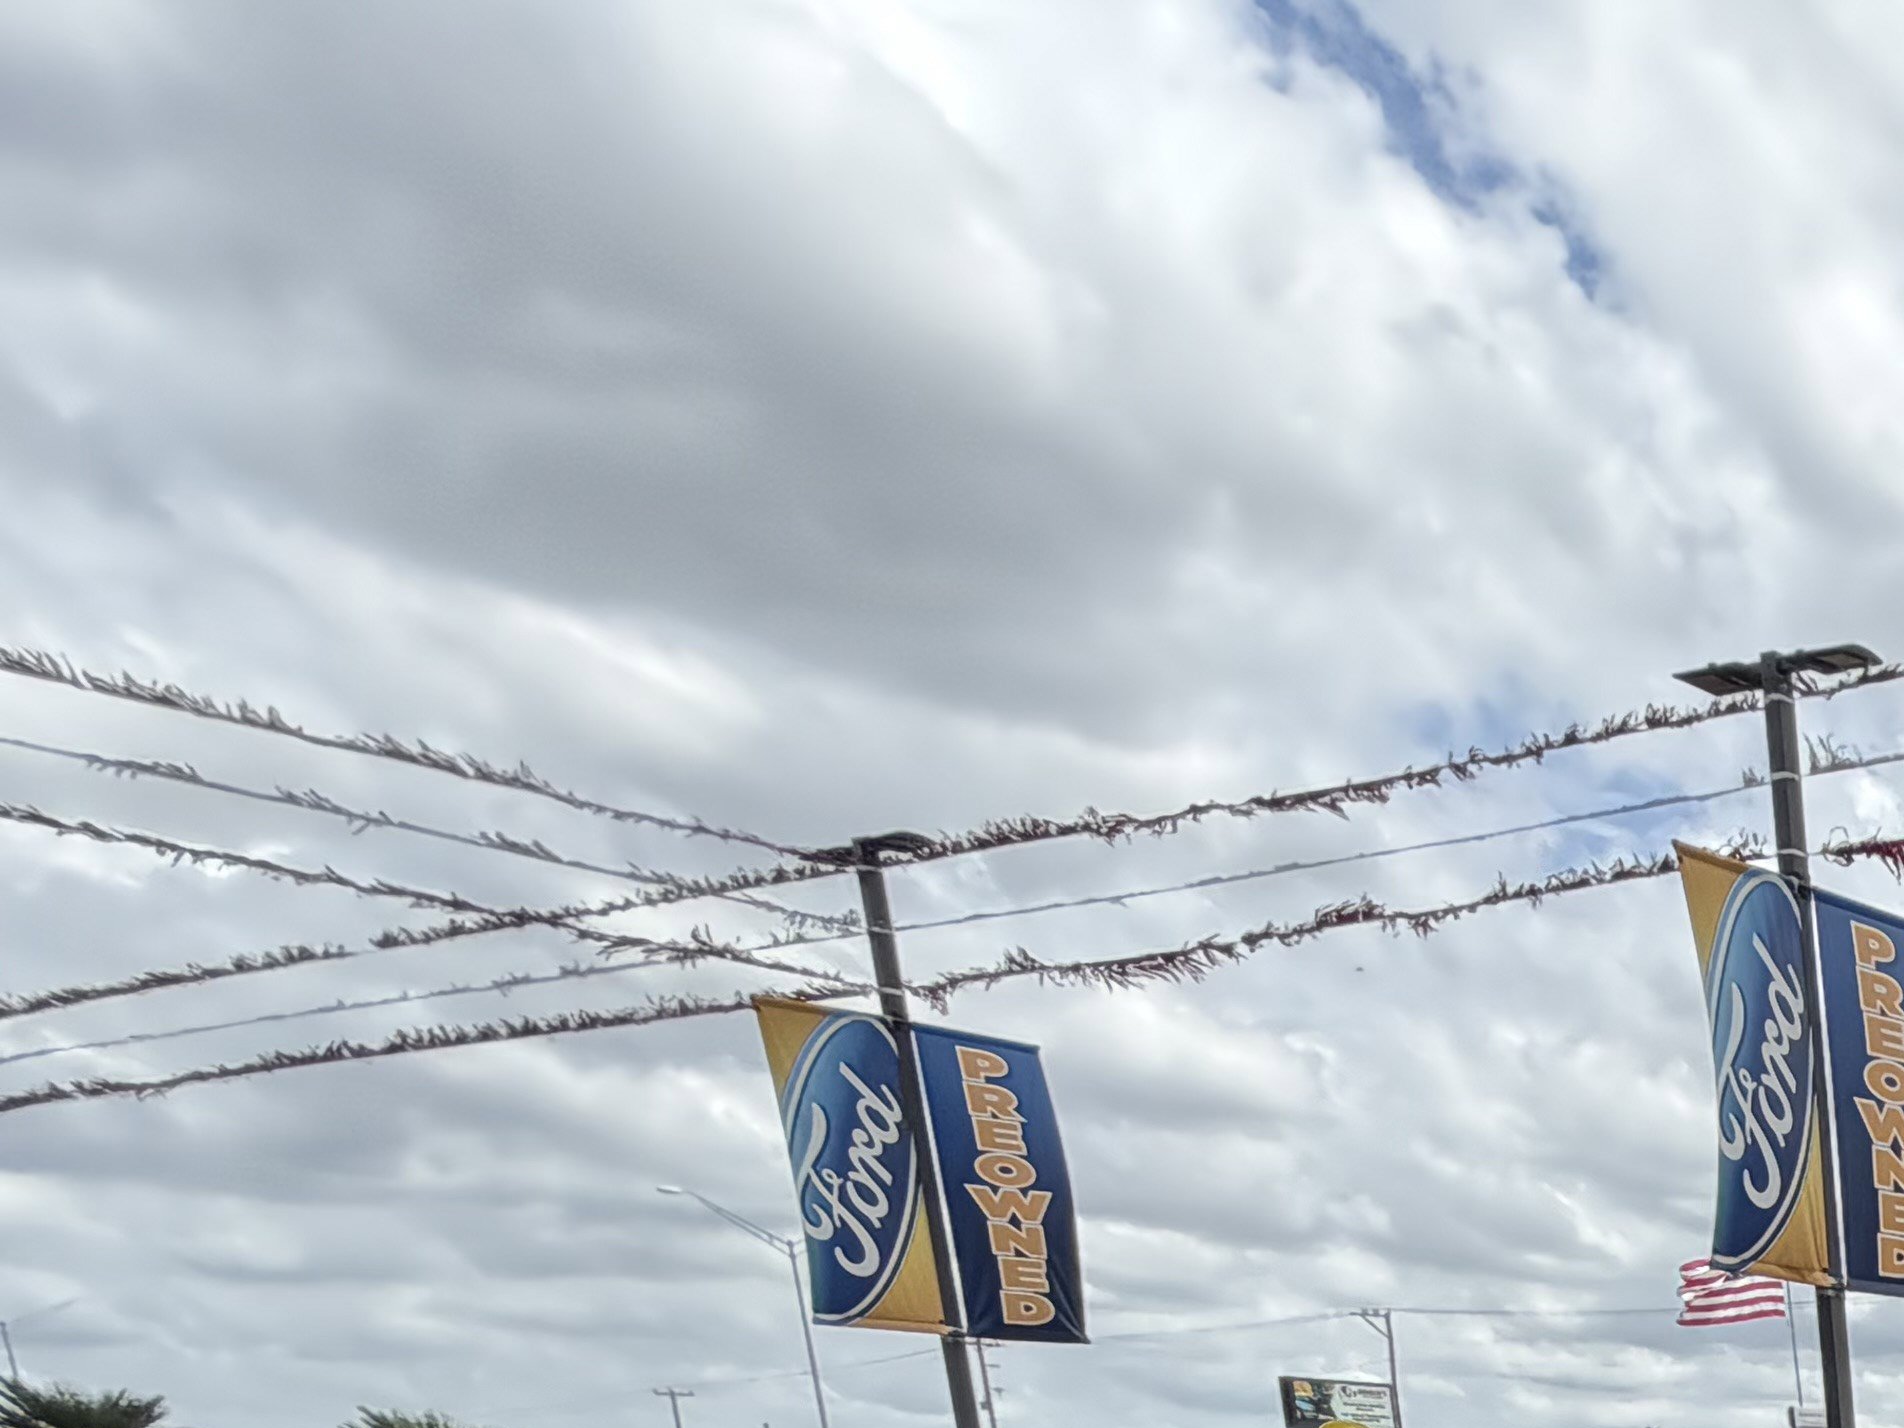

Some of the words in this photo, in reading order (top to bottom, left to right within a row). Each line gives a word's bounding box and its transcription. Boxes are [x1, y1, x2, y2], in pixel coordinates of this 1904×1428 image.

[801, 1062, 903, 1278] Ford
[955, 1045, 1056, 1326] PREOWNED
[1716, 932, 1804, 1209] Ford
